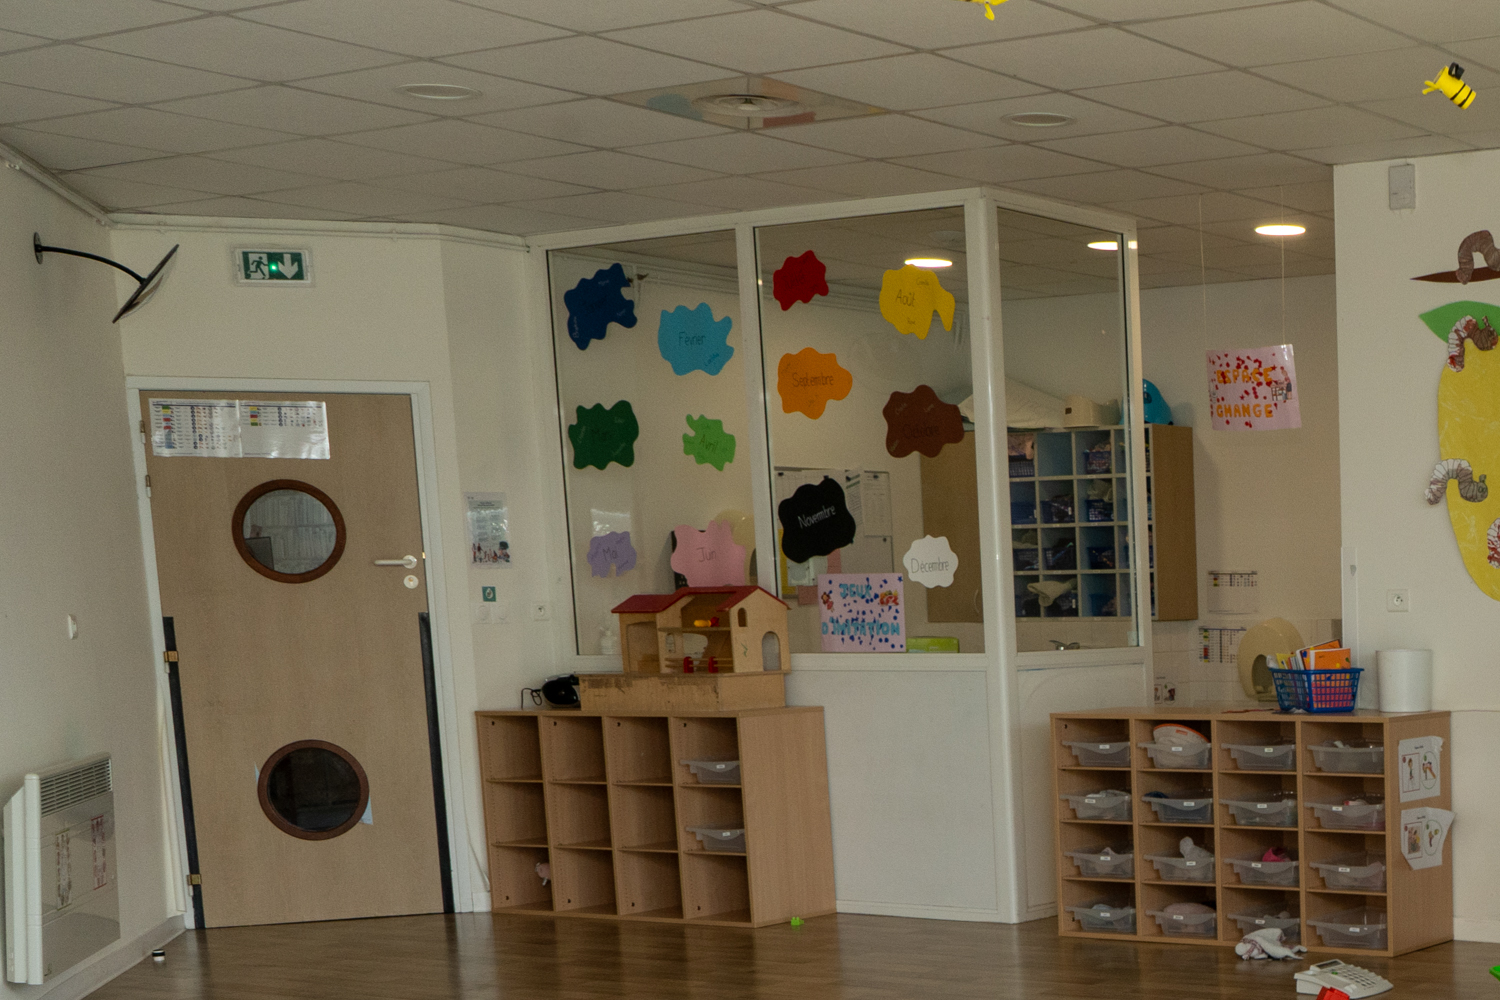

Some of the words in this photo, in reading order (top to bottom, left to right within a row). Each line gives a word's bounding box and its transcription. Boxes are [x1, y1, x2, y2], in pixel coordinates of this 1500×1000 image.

[895, 289, 916, 307] Août
[792, 372, 834, 388] Septembre
[1216, 367, 1274, 384] ESPACE
[1216, 403, 1273, 418] CHANGE
[797, 505, 836, 529] Novembre
[910, 557, 949, 574] Décembre
[839, 583, 872, 599] JEUX
